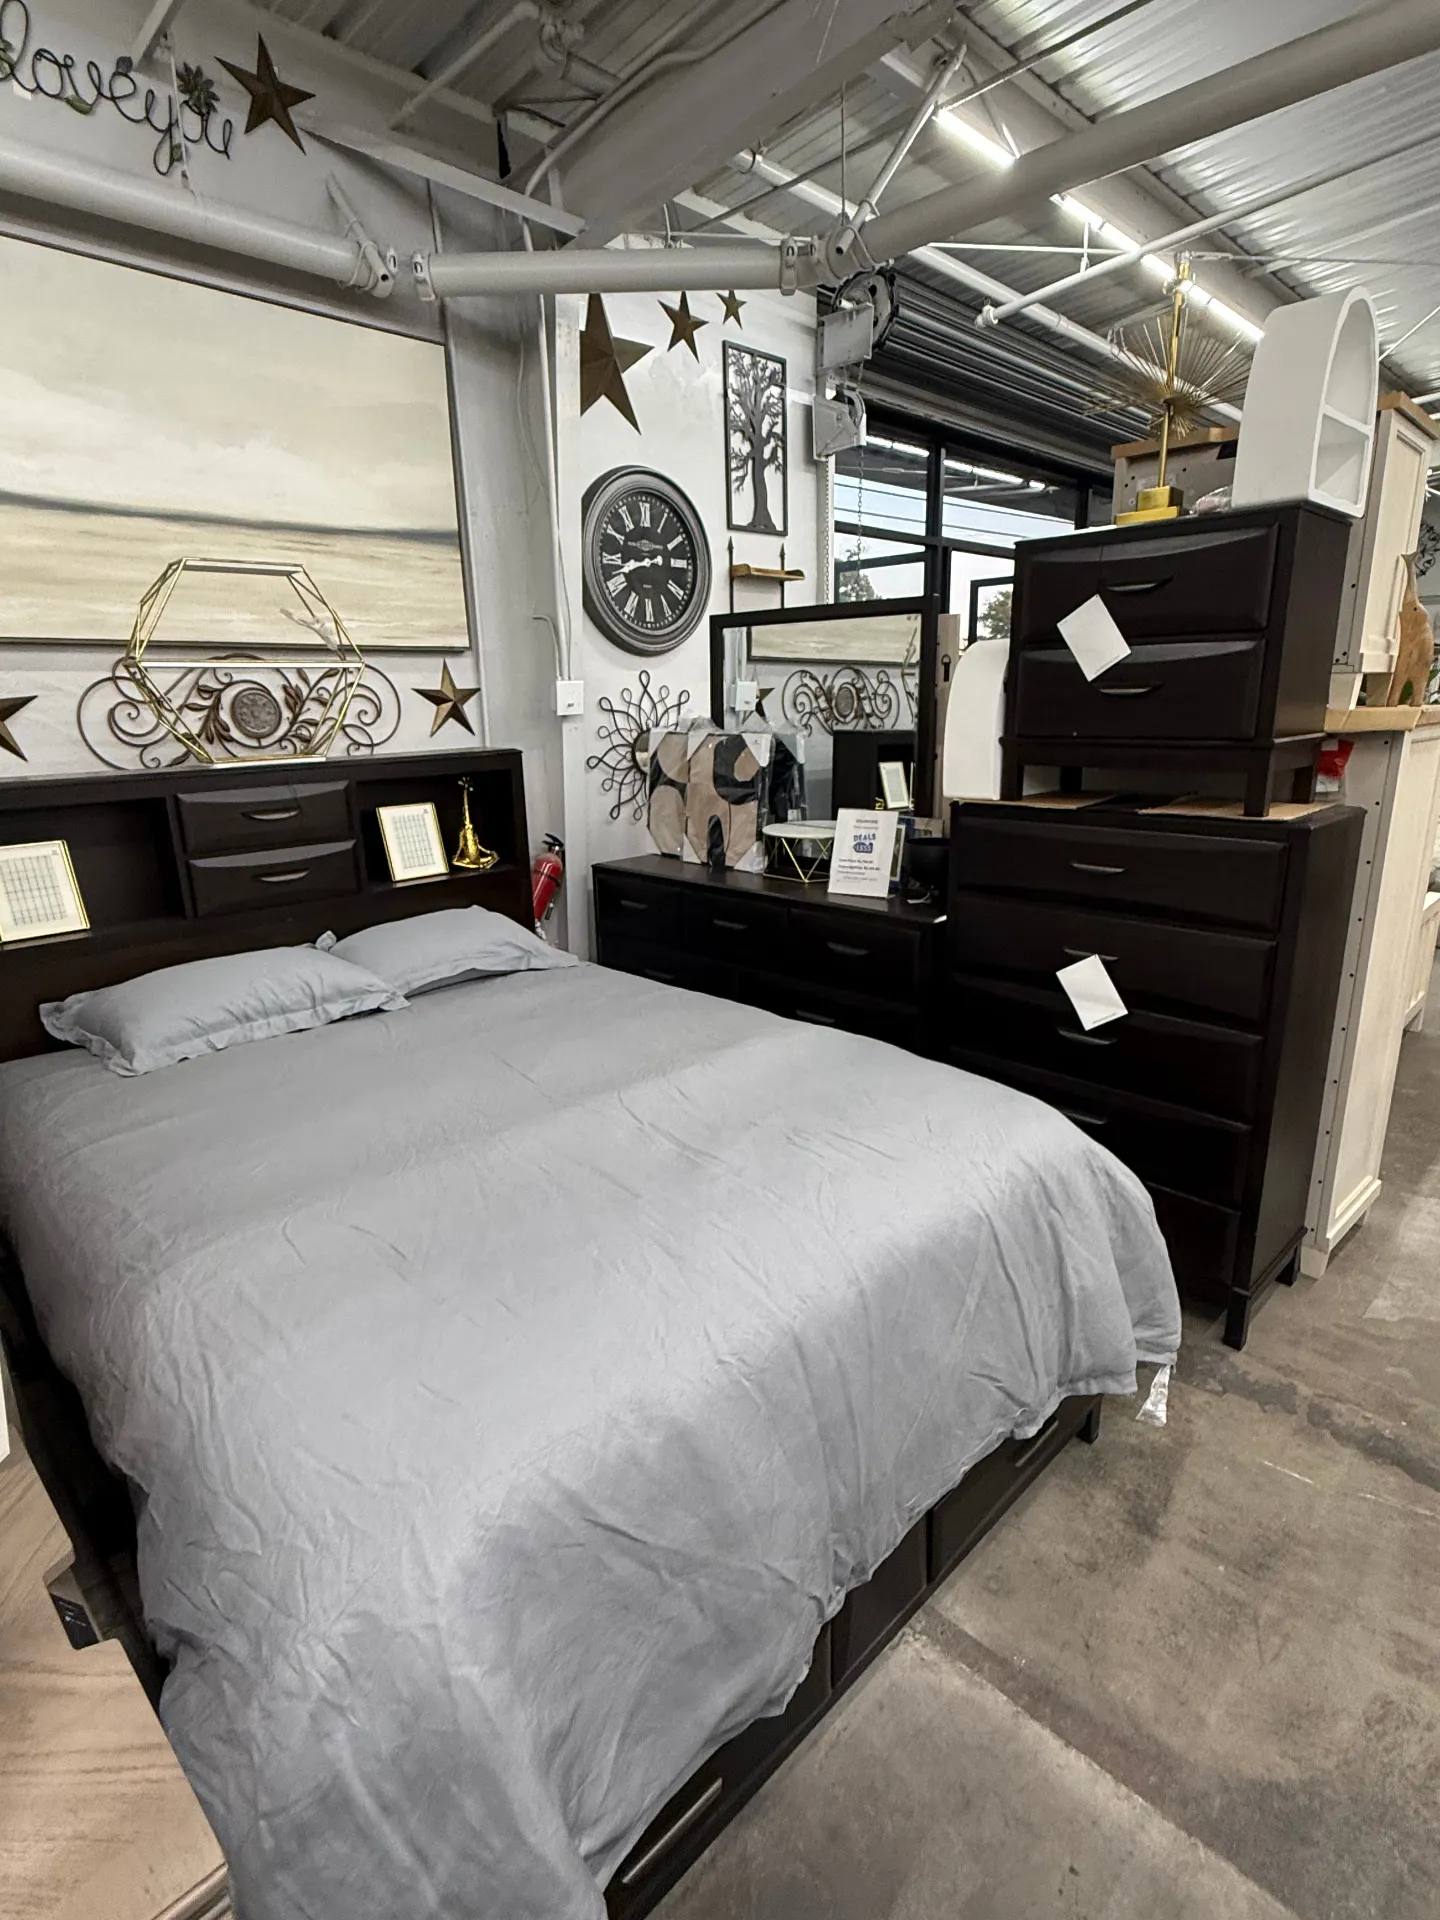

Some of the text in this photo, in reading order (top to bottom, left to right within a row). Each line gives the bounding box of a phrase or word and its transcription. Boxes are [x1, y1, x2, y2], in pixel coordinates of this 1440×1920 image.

[618, 505, 635, 533] XI
[639, 502, 651, 528] XII
[657, 512, 668, 534] I
[606, 524, 625, 546] X
[853, 833, 876, 842] DEALS
[856, 844, 872, 852] LESS
